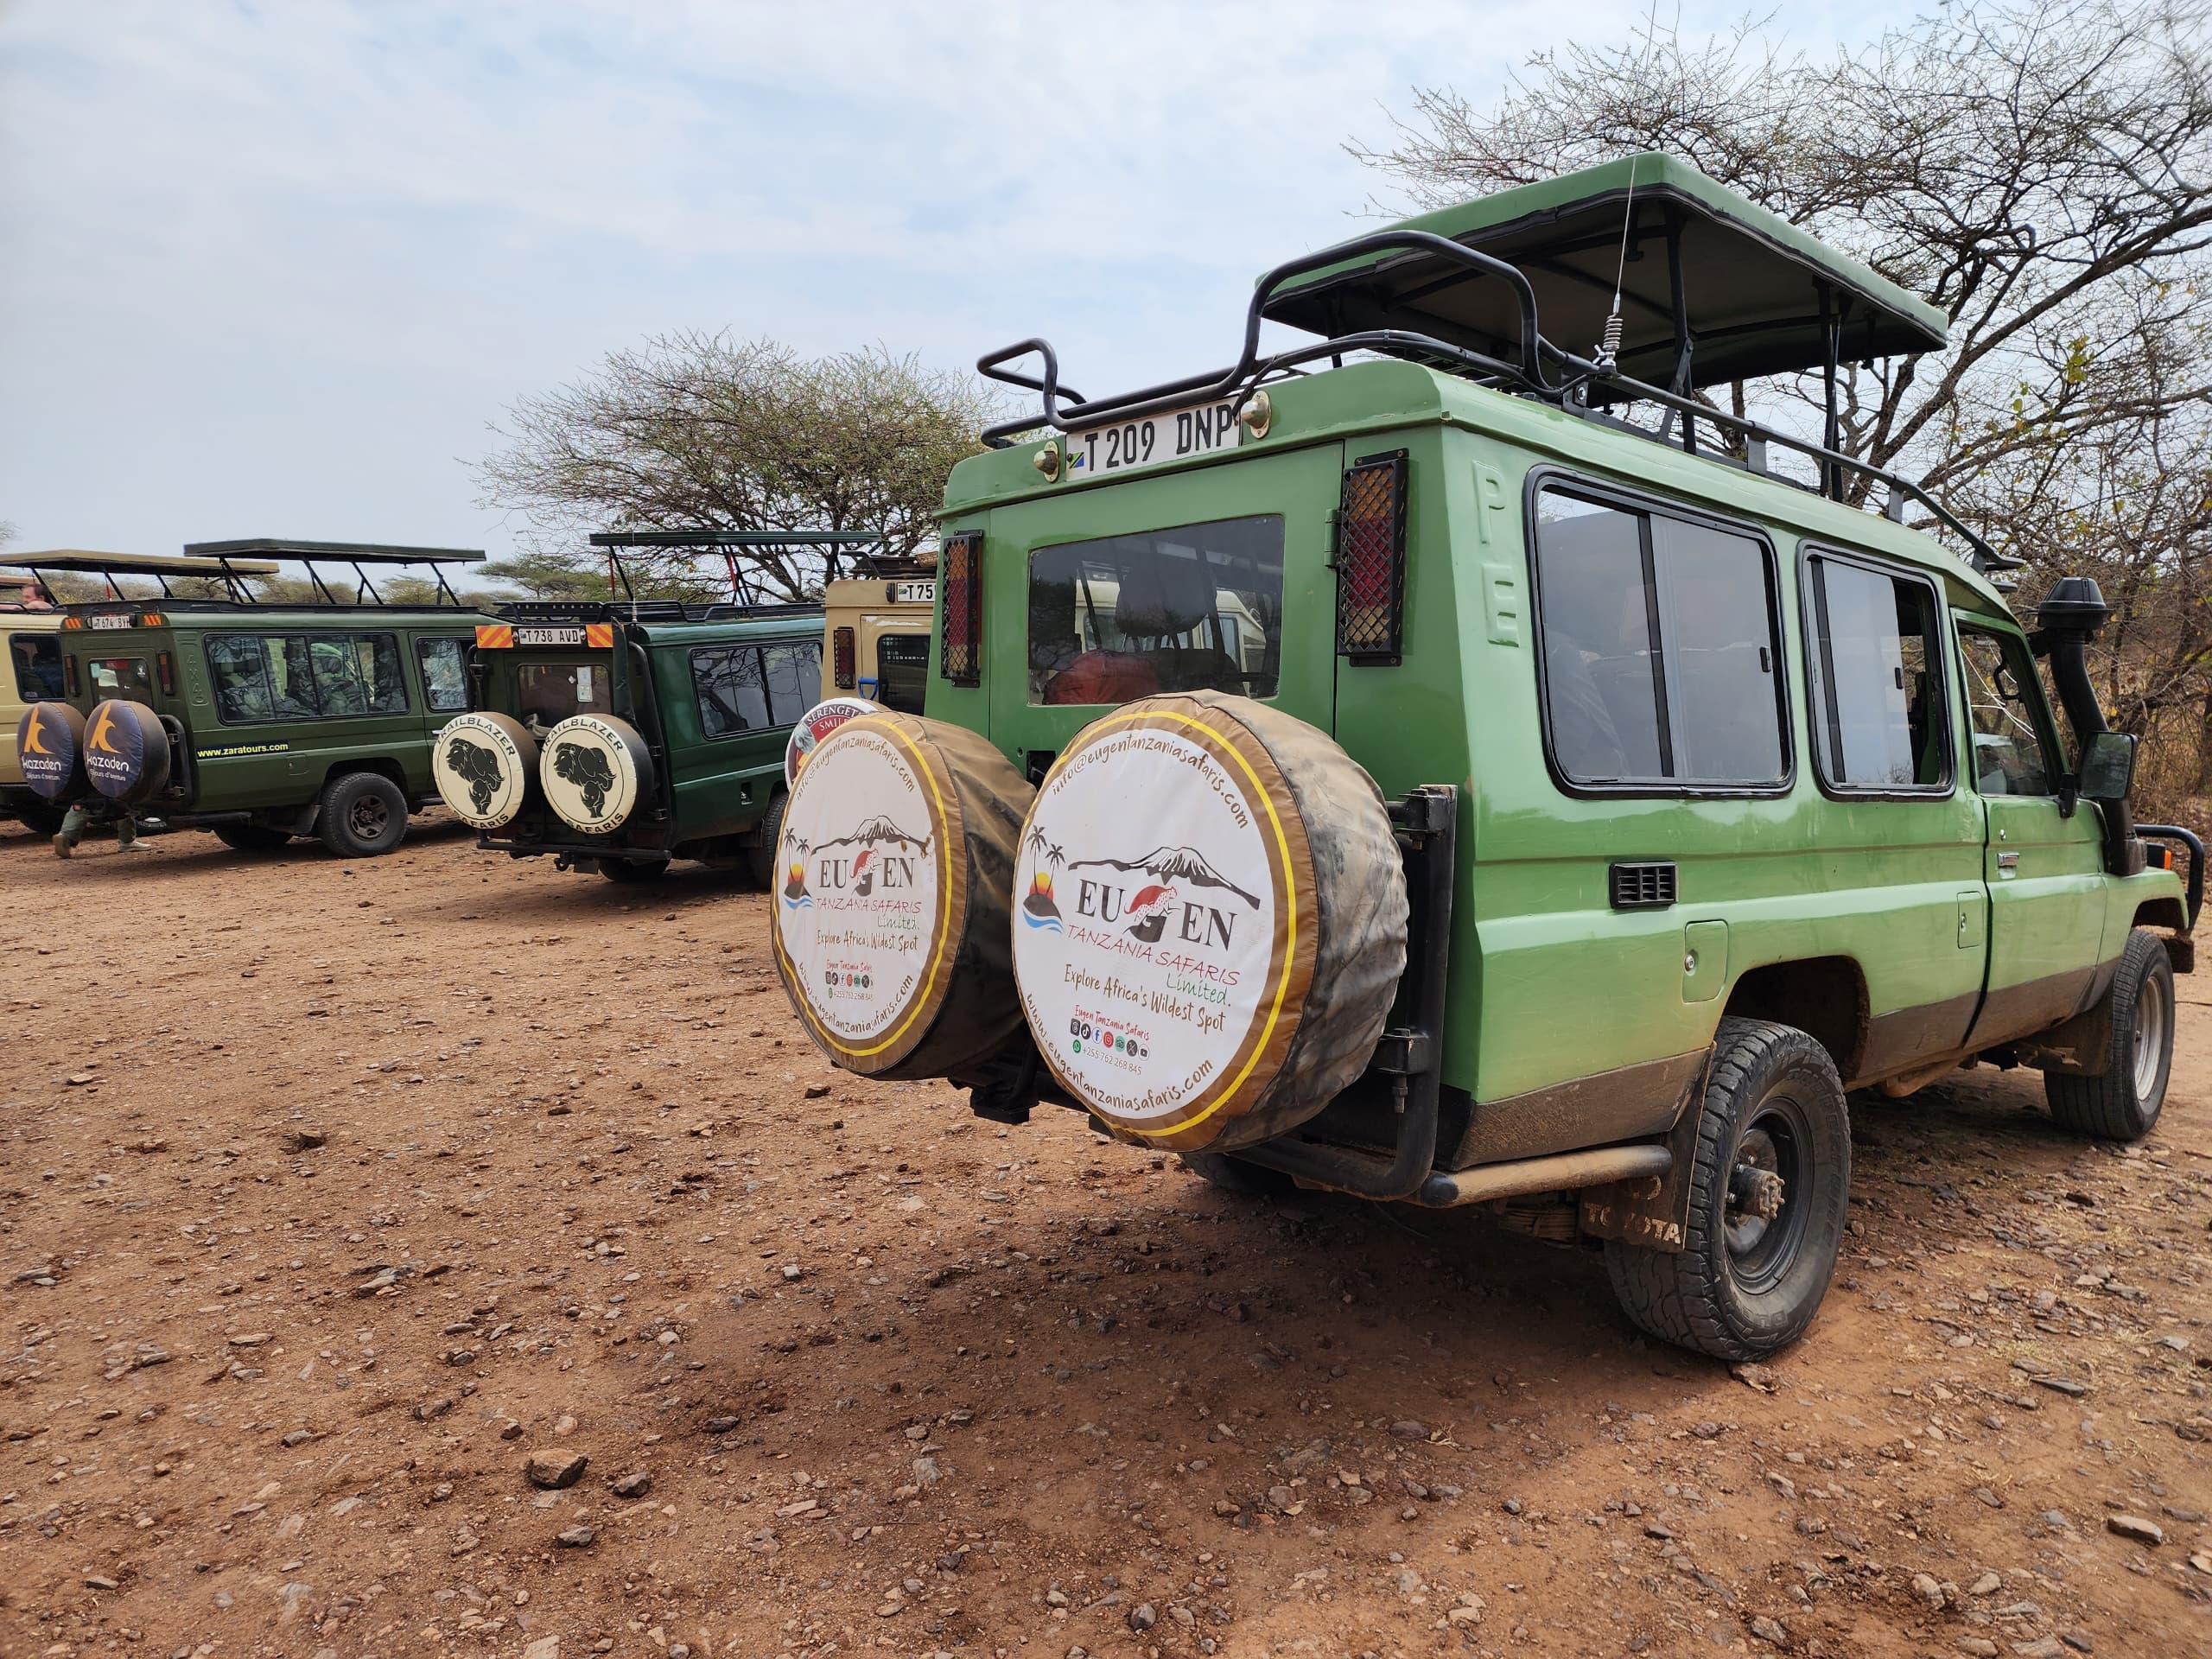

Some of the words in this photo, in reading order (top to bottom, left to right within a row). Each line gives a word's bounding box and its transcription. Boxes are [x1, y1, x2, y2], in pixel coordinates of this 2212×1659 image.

[1085, 433, 1098, 471] T
[1106, 421, 1155, 468] 209
[1176, 404, 1233, 454] DNP
[907, 585, 913, 600] T
[917, 585, 937, 600] 75
[525, 631, 531, 642] T
[534, 630, 553, 642] 738
[559, 630, 578, 642] AVD
[807, 705, 861, 725] SERENGET
[541, 718, 623, 753] TRAILBLAZER
[22, 755, 61, 771] kazaden
[86, 752, 129, 772] kazaden
[197, 743, 289, 758] www.zaratours.com
[1052, 734, 1249, 830] info@eugentanzaniasafaris.com
[455, 812, 509, 829] AFARIS
[564, 812, 624, 835] SAFARIS
[817, 898, 868, 912] TANZANIA
[871, 899, 922, 914] SAFARIS
[817, 929, 841, 947] Explore
[899, 934, 918, 956] Spot
[1068, 925, 1153, 963] TANZANIA
[1155, 952, 1240, 986] SAFARIS
[1065, 963, 1100, 991] Explore
[1103, 976, 1147, 1007] Africa's
[1151, 993, 1194, 1021] Wildest
[1197, 1007, 1226, 1034] Spot
[1166, 973, 1231, 1007] Limited.
[1074, 1004, 1094, 1023] Eugen
[1095, 1010, 1124, 1031] Tanzania
[1125, 1020, 1149, 1041] Safaris
[1027, 993, 1214, 1111] www.eugentanzaniasafaris.com
[1083, 1046, 1099, 1059] +255
[1101, 1052, 1113, 1065] 762
[1114, 1057, 1127, 1070] 268
[1128, 1061, 1141, 1075] 845
